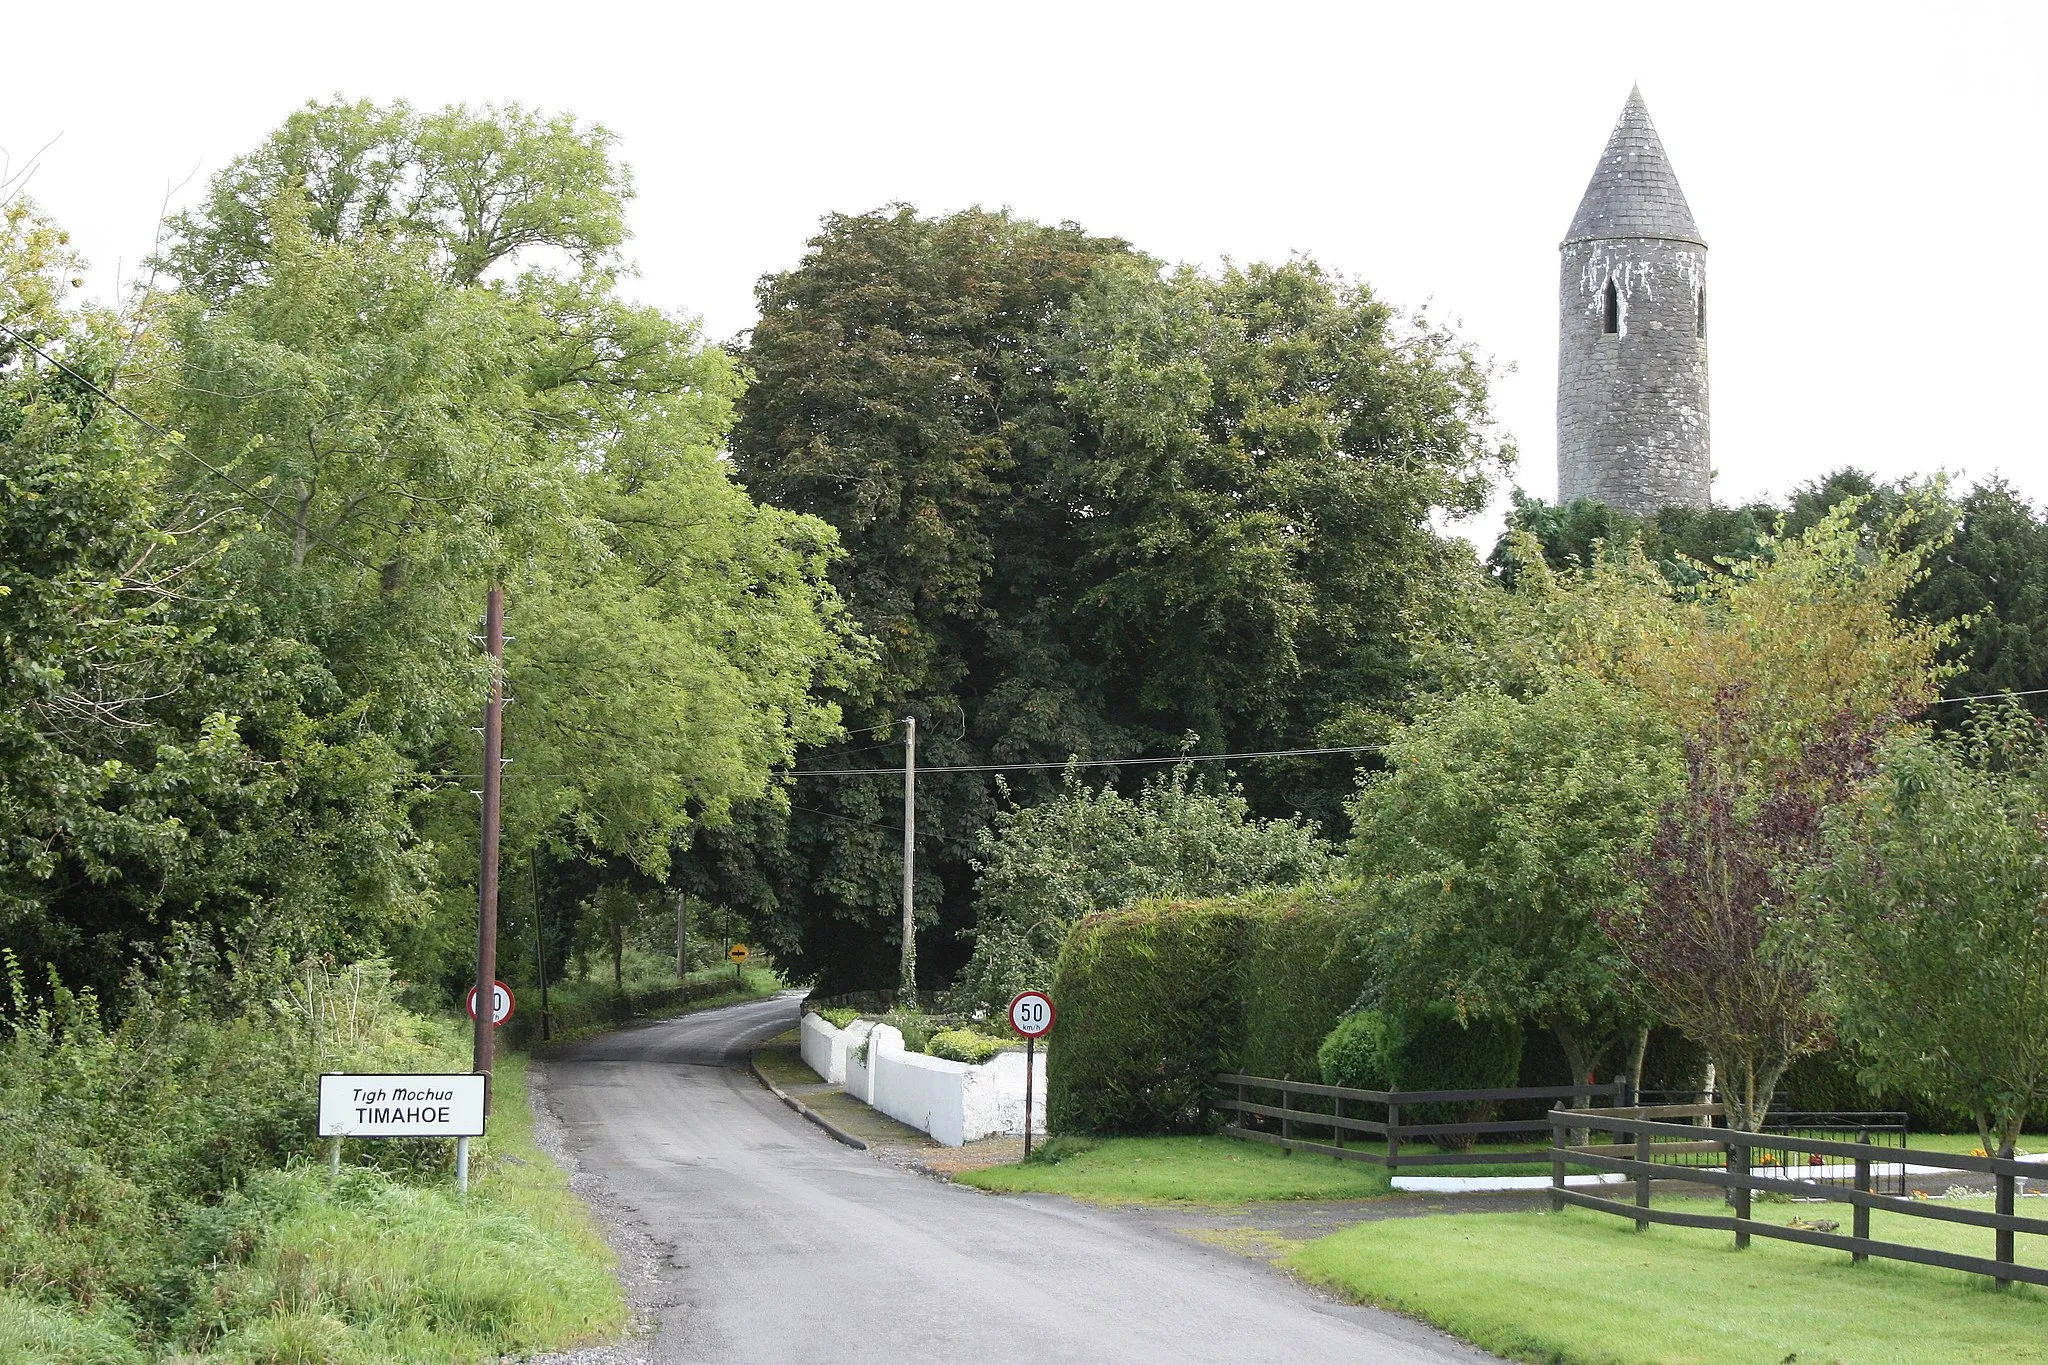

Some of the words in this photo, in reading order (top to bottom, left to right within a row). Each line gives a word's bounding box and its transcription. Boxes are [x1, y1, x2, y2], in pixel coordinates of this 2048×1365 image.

[1021, 1003, 1043, 1022] 50
[353, 1089, 386, 1104] Tigh
[392, 1088, 453, 1101] Mochua
[355, 1107, 450, 1123] TIMAHOE
